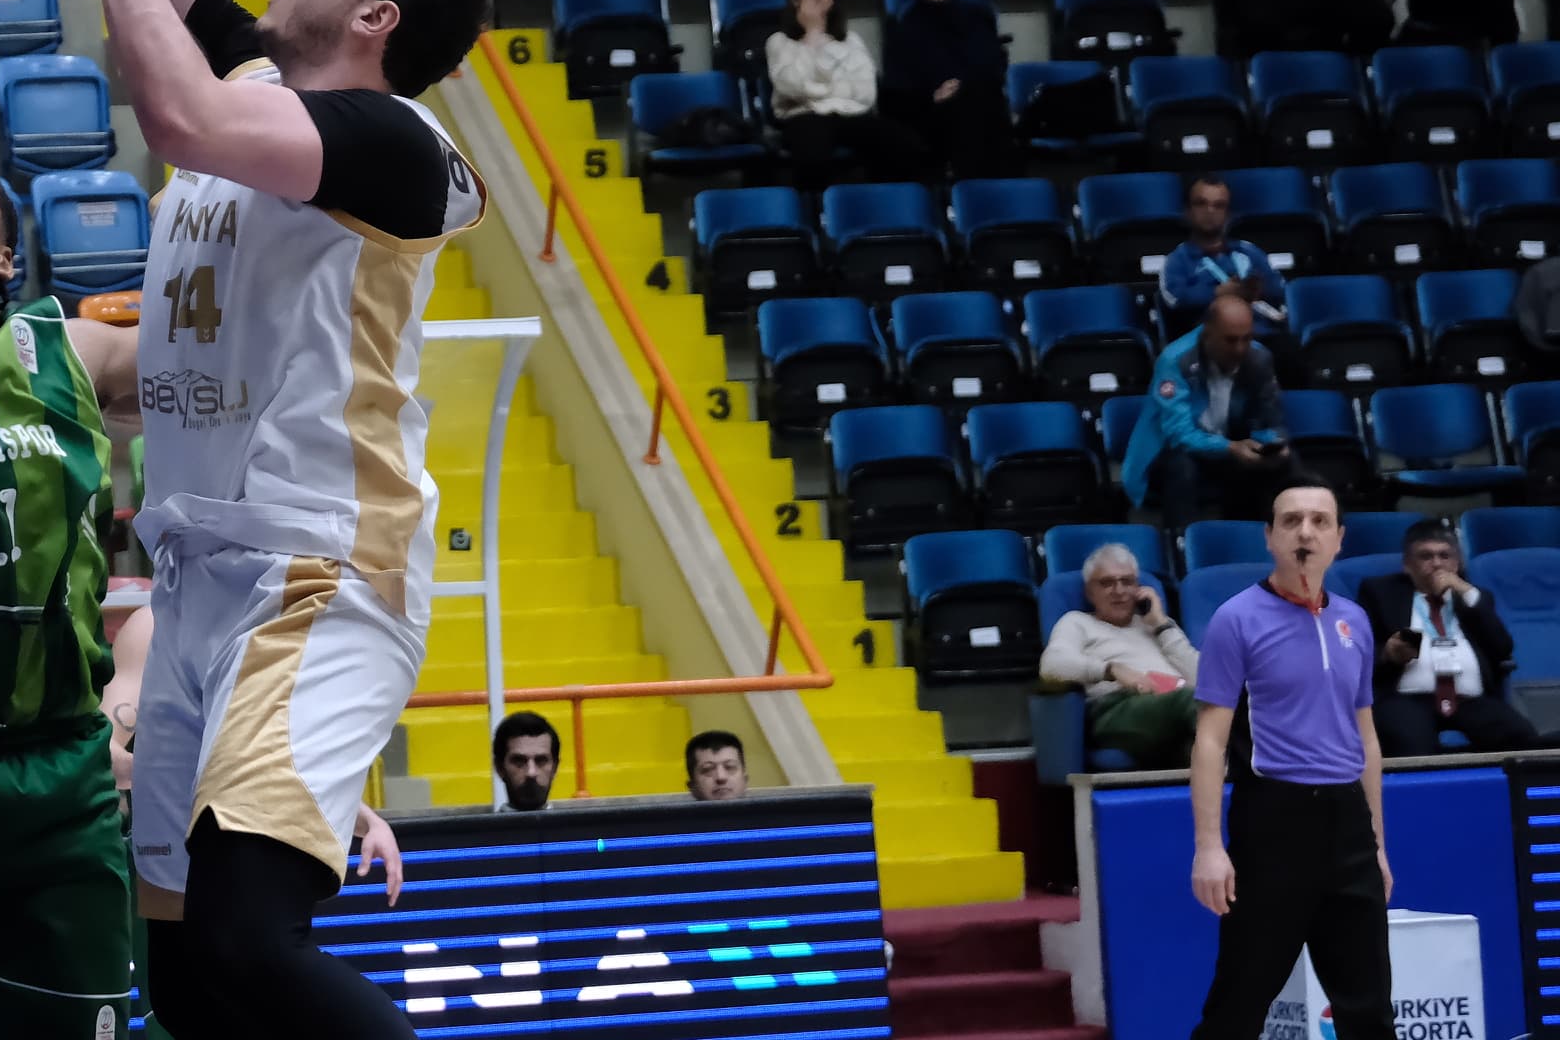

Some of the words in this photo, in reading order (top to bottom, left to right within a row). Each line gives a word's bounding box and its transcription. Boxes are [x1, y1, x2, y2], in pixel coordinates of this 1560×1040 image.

[508, 37, 531, 64] 6
[585, 149, 608, 178] 5
[647, 261, 670, 290] 4
[163, 265, 222, 343] 14
[708, 389, 731, 420] 3
[775, 503, 801, 537] 2
[853, 629, 875, 665] 1
[1393, 997, 1470, 1018] RKİYE
[1393, 1020, 1473, 1040] GORTA
